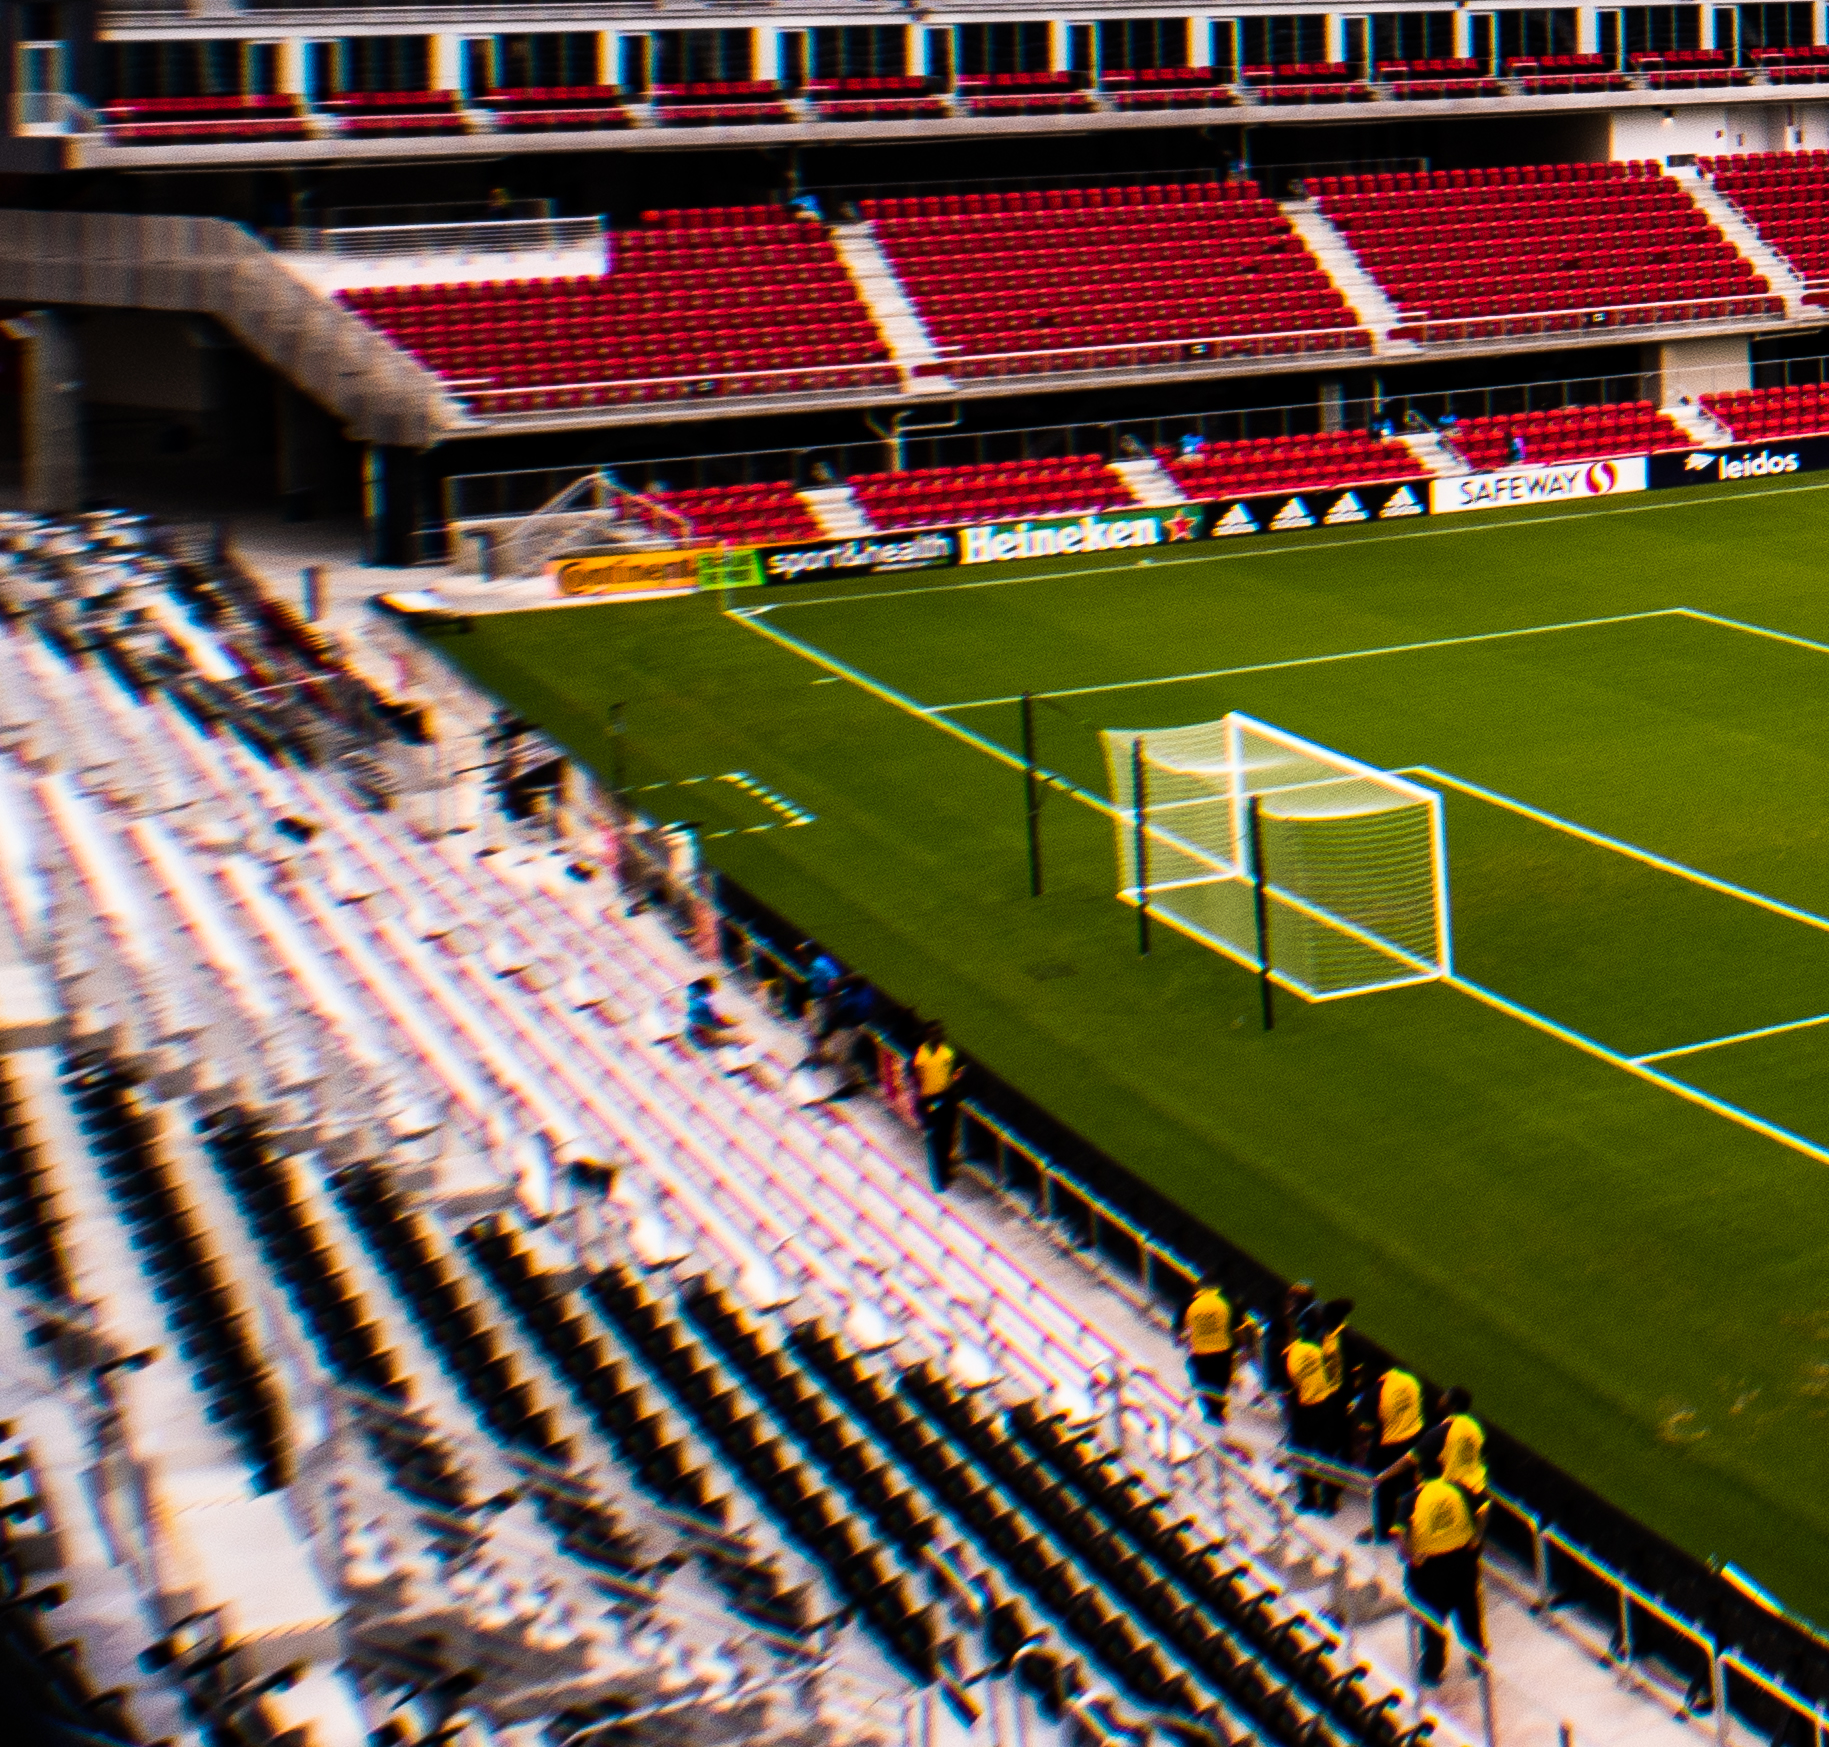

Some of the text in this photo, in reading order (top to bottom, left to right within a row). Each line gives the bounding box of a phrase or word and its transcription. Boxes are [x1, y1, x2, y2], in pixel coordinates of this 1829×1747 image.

[1718, 449, 1800, 480] leidos
[1459, 469, 1582, 506] SAFEWAY
[958, 515, 1166, 565] Heineken
